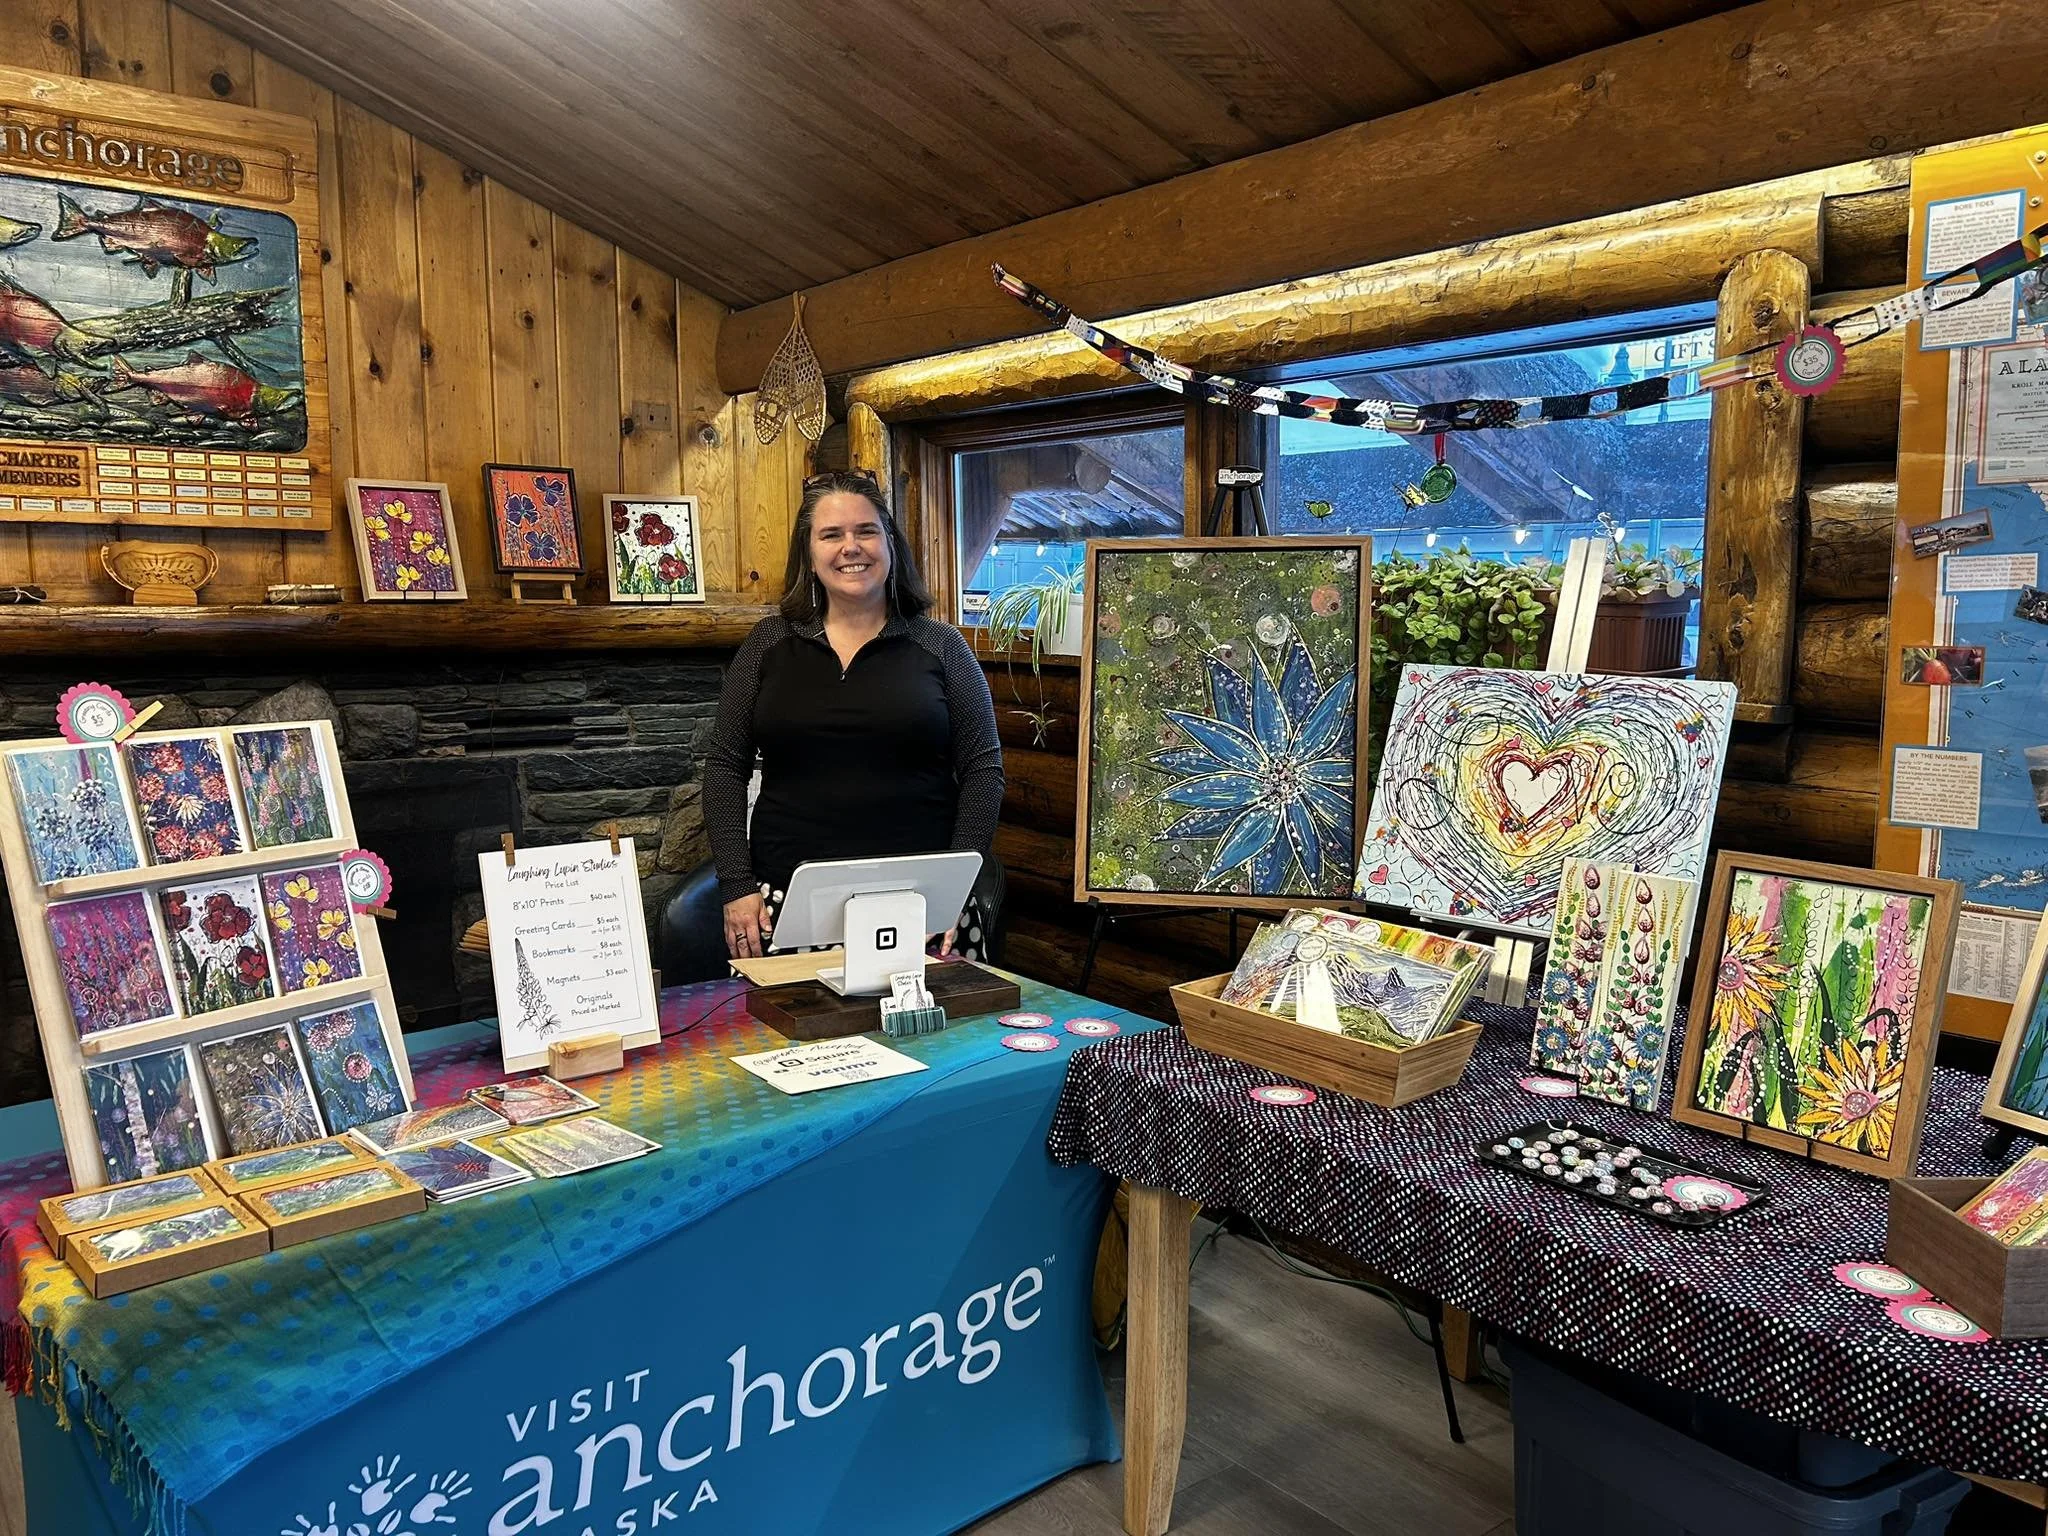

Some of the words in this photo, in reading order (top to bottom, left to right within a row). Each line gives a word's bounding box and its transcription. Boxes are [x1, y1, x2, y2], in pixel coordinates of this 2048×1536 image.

[1975, 200, 1994, 208] TIDES
[1942, 288, 1970, 297] BEWARE
[1654, 341, 1703, 362] GIFT
[1803, 355, 1818, 366] $35
[0, 451, 80, 469] CHARTER
[0, 470, 80, 487] MEMBERS
[1220, 471, 1261, 482] anchorage
[91, 714, 104, 724] $5
[508, 866, 550, 882] Laughing
[554, 862, 580, 877] Lupin
[545, 880, 564, 889] Price
[540, 898, 564, 907] Prints
[590, 892, 603, 901] $40
[514, 925, 550, 936] Greeting
[552, 920, 576, 930] Cards
[532, 945, 576, 959] Bookmarks
[546, 974, 580, 986] Magnets
[605, 968, 614, 977] $3
[576, 990, 613, 1005] Originals
[571, 1007, 590, 1016] Priced
[599, 1001, 621, 1010] Marked
[804, 1050, 860, 1063] Square
[807, 1060, 878, 1076] venmo
[488, 1266, 1042, 1536] anchorage
[506, 1368, 650, 1442] VISIT
